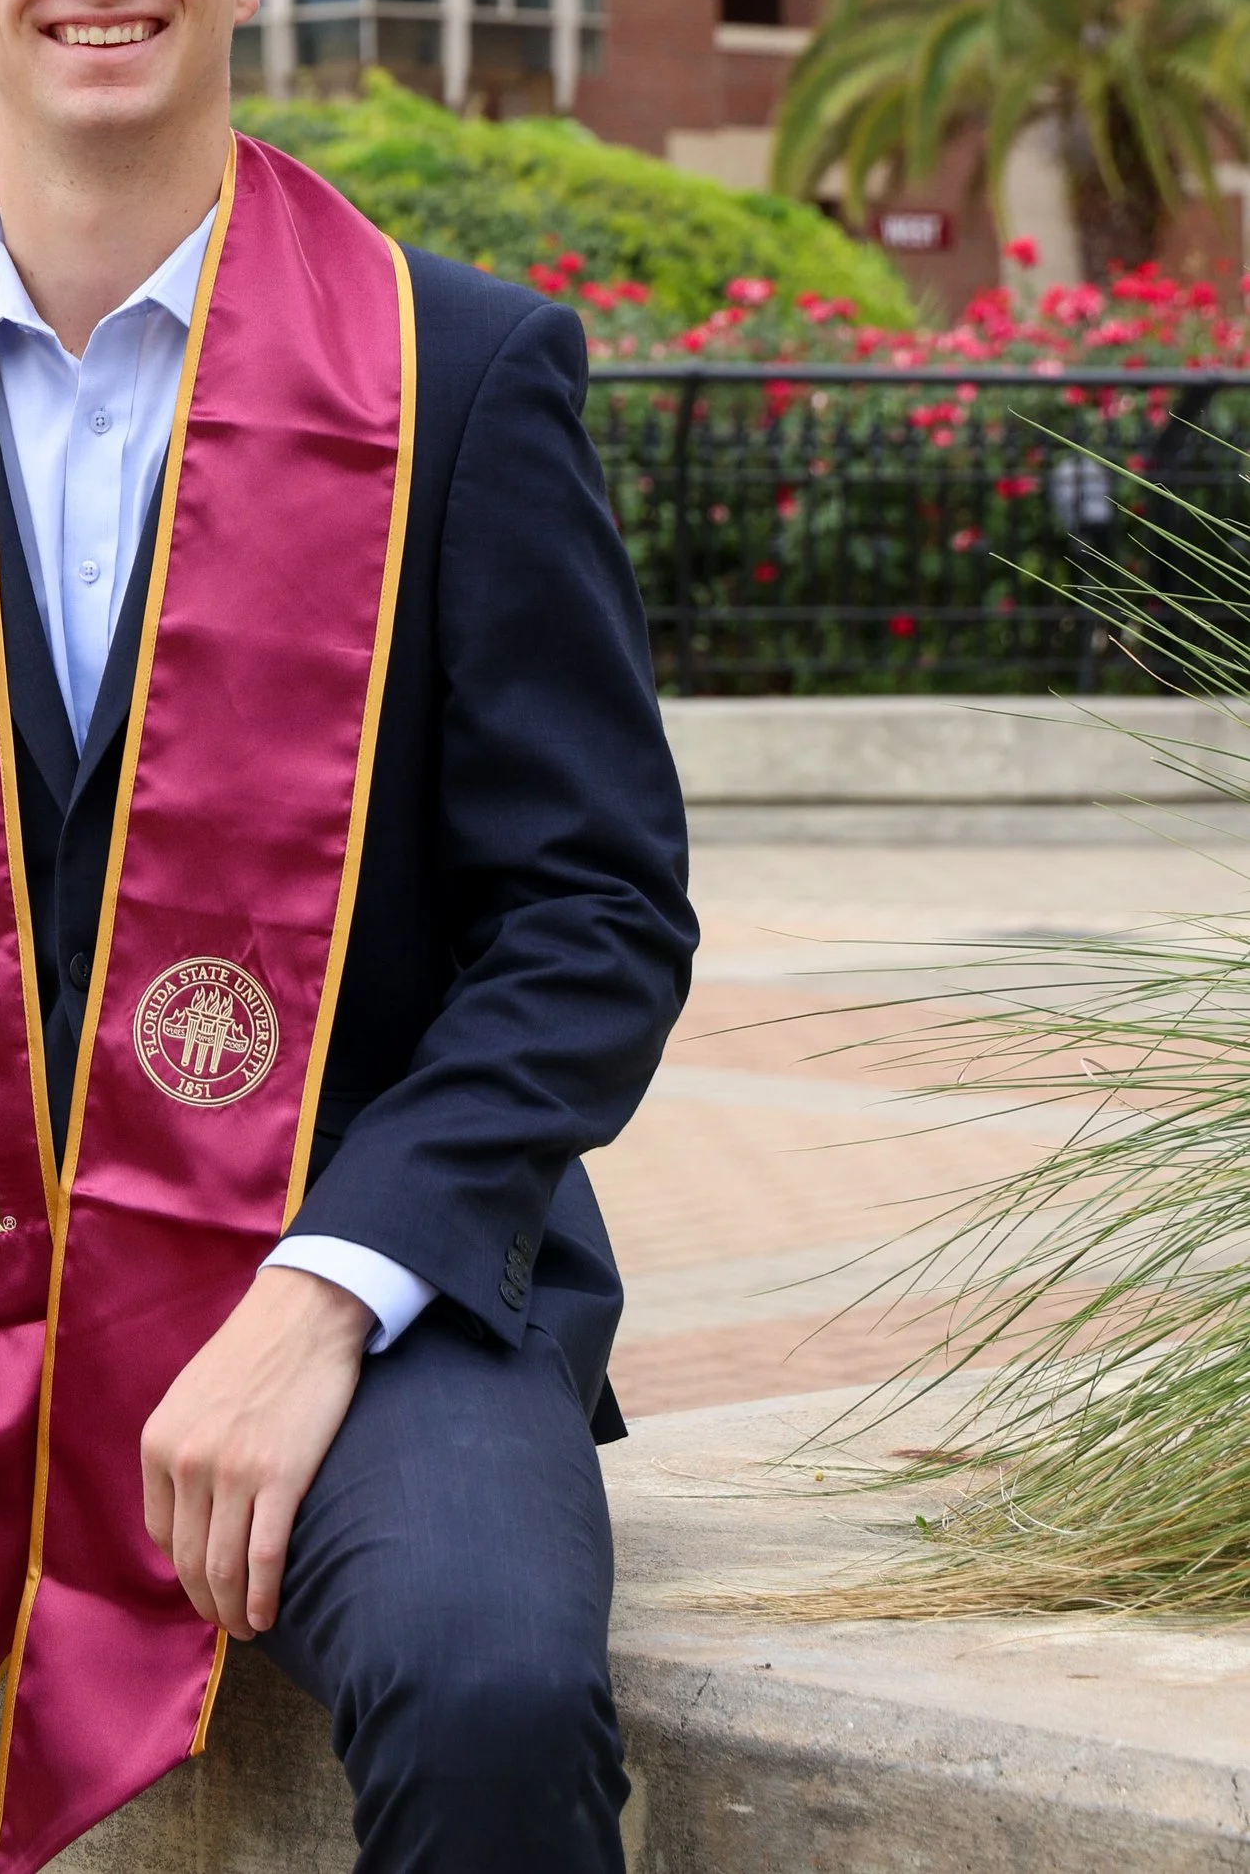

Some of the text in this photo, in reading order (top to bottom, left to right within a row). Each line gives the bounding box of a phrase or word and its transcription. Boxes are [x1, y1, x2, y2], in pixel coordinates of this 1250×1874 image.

[144, 966, 269, 1081] FLORIDA STATE UNIVERSITY
[176, 1078, 211, 1098] 1851
